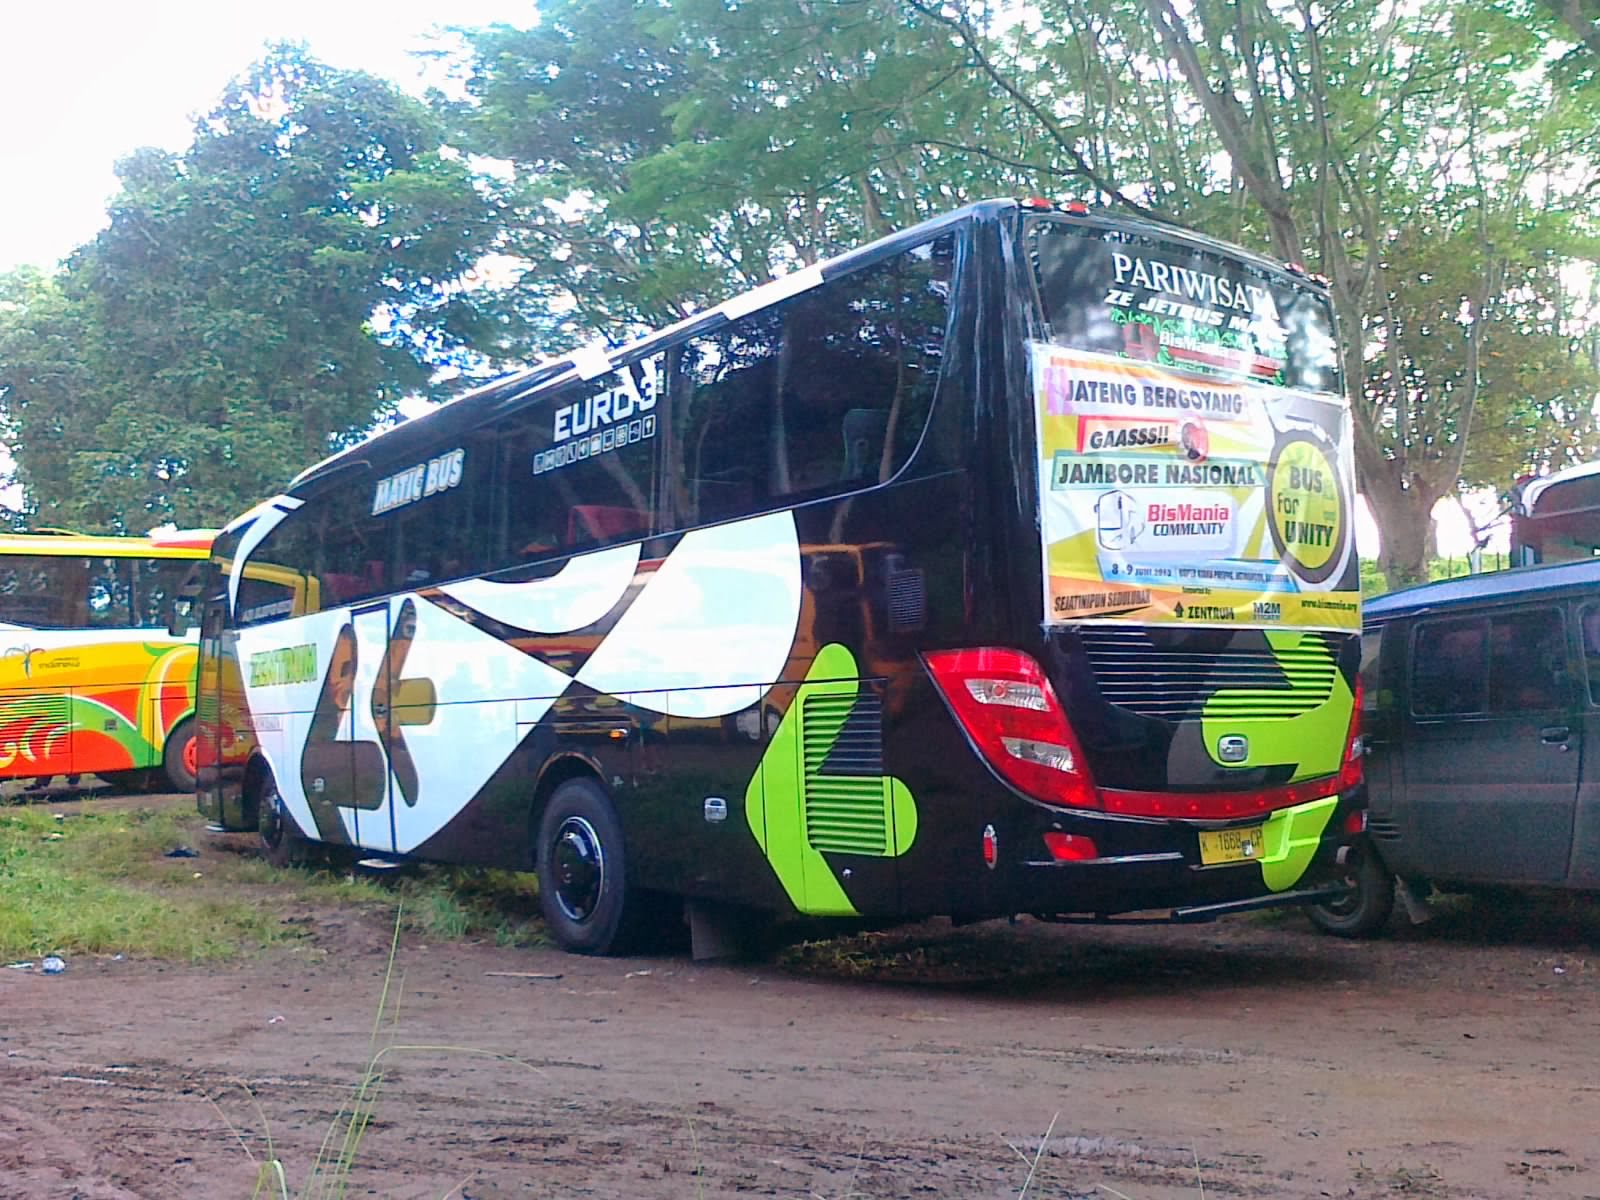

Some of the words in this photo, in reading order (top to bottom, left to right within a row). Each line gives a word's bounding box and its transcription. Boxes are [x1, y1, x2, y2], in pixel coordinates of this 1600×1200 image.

[1104, 289, 1135, 307] ZE
[1139, 297, 1226, 326] JETBUS
[1065, 380, 1136, 406] JATENG
[1143, 385, 1243, 415] BERGOYANG
[1089, 425, 1169, 450] GAASSS!!
[371, 461, 426, 516] MATIC
[424, 447, 465, 498] BUS
[1058, 463, 1159, 485] JAMBORE
[1165, 464, 1256, 486] NASIONAL
[1289, 467, 1323, 494] BUS
[1147, 503, 1230, 523] BisMania
[1277, 494, 1300, 515] For
[1152, 522, 1226, 537] COMMUNITY
[1284, 520, 1335, 548] UNITY
[1111, 563, 1119, 575] 8
[1126, 564, 1133, 576] 9
[1187, 606, 1235, 620] ZENTRUM
[1252, 602, 1281, 614] M2M
